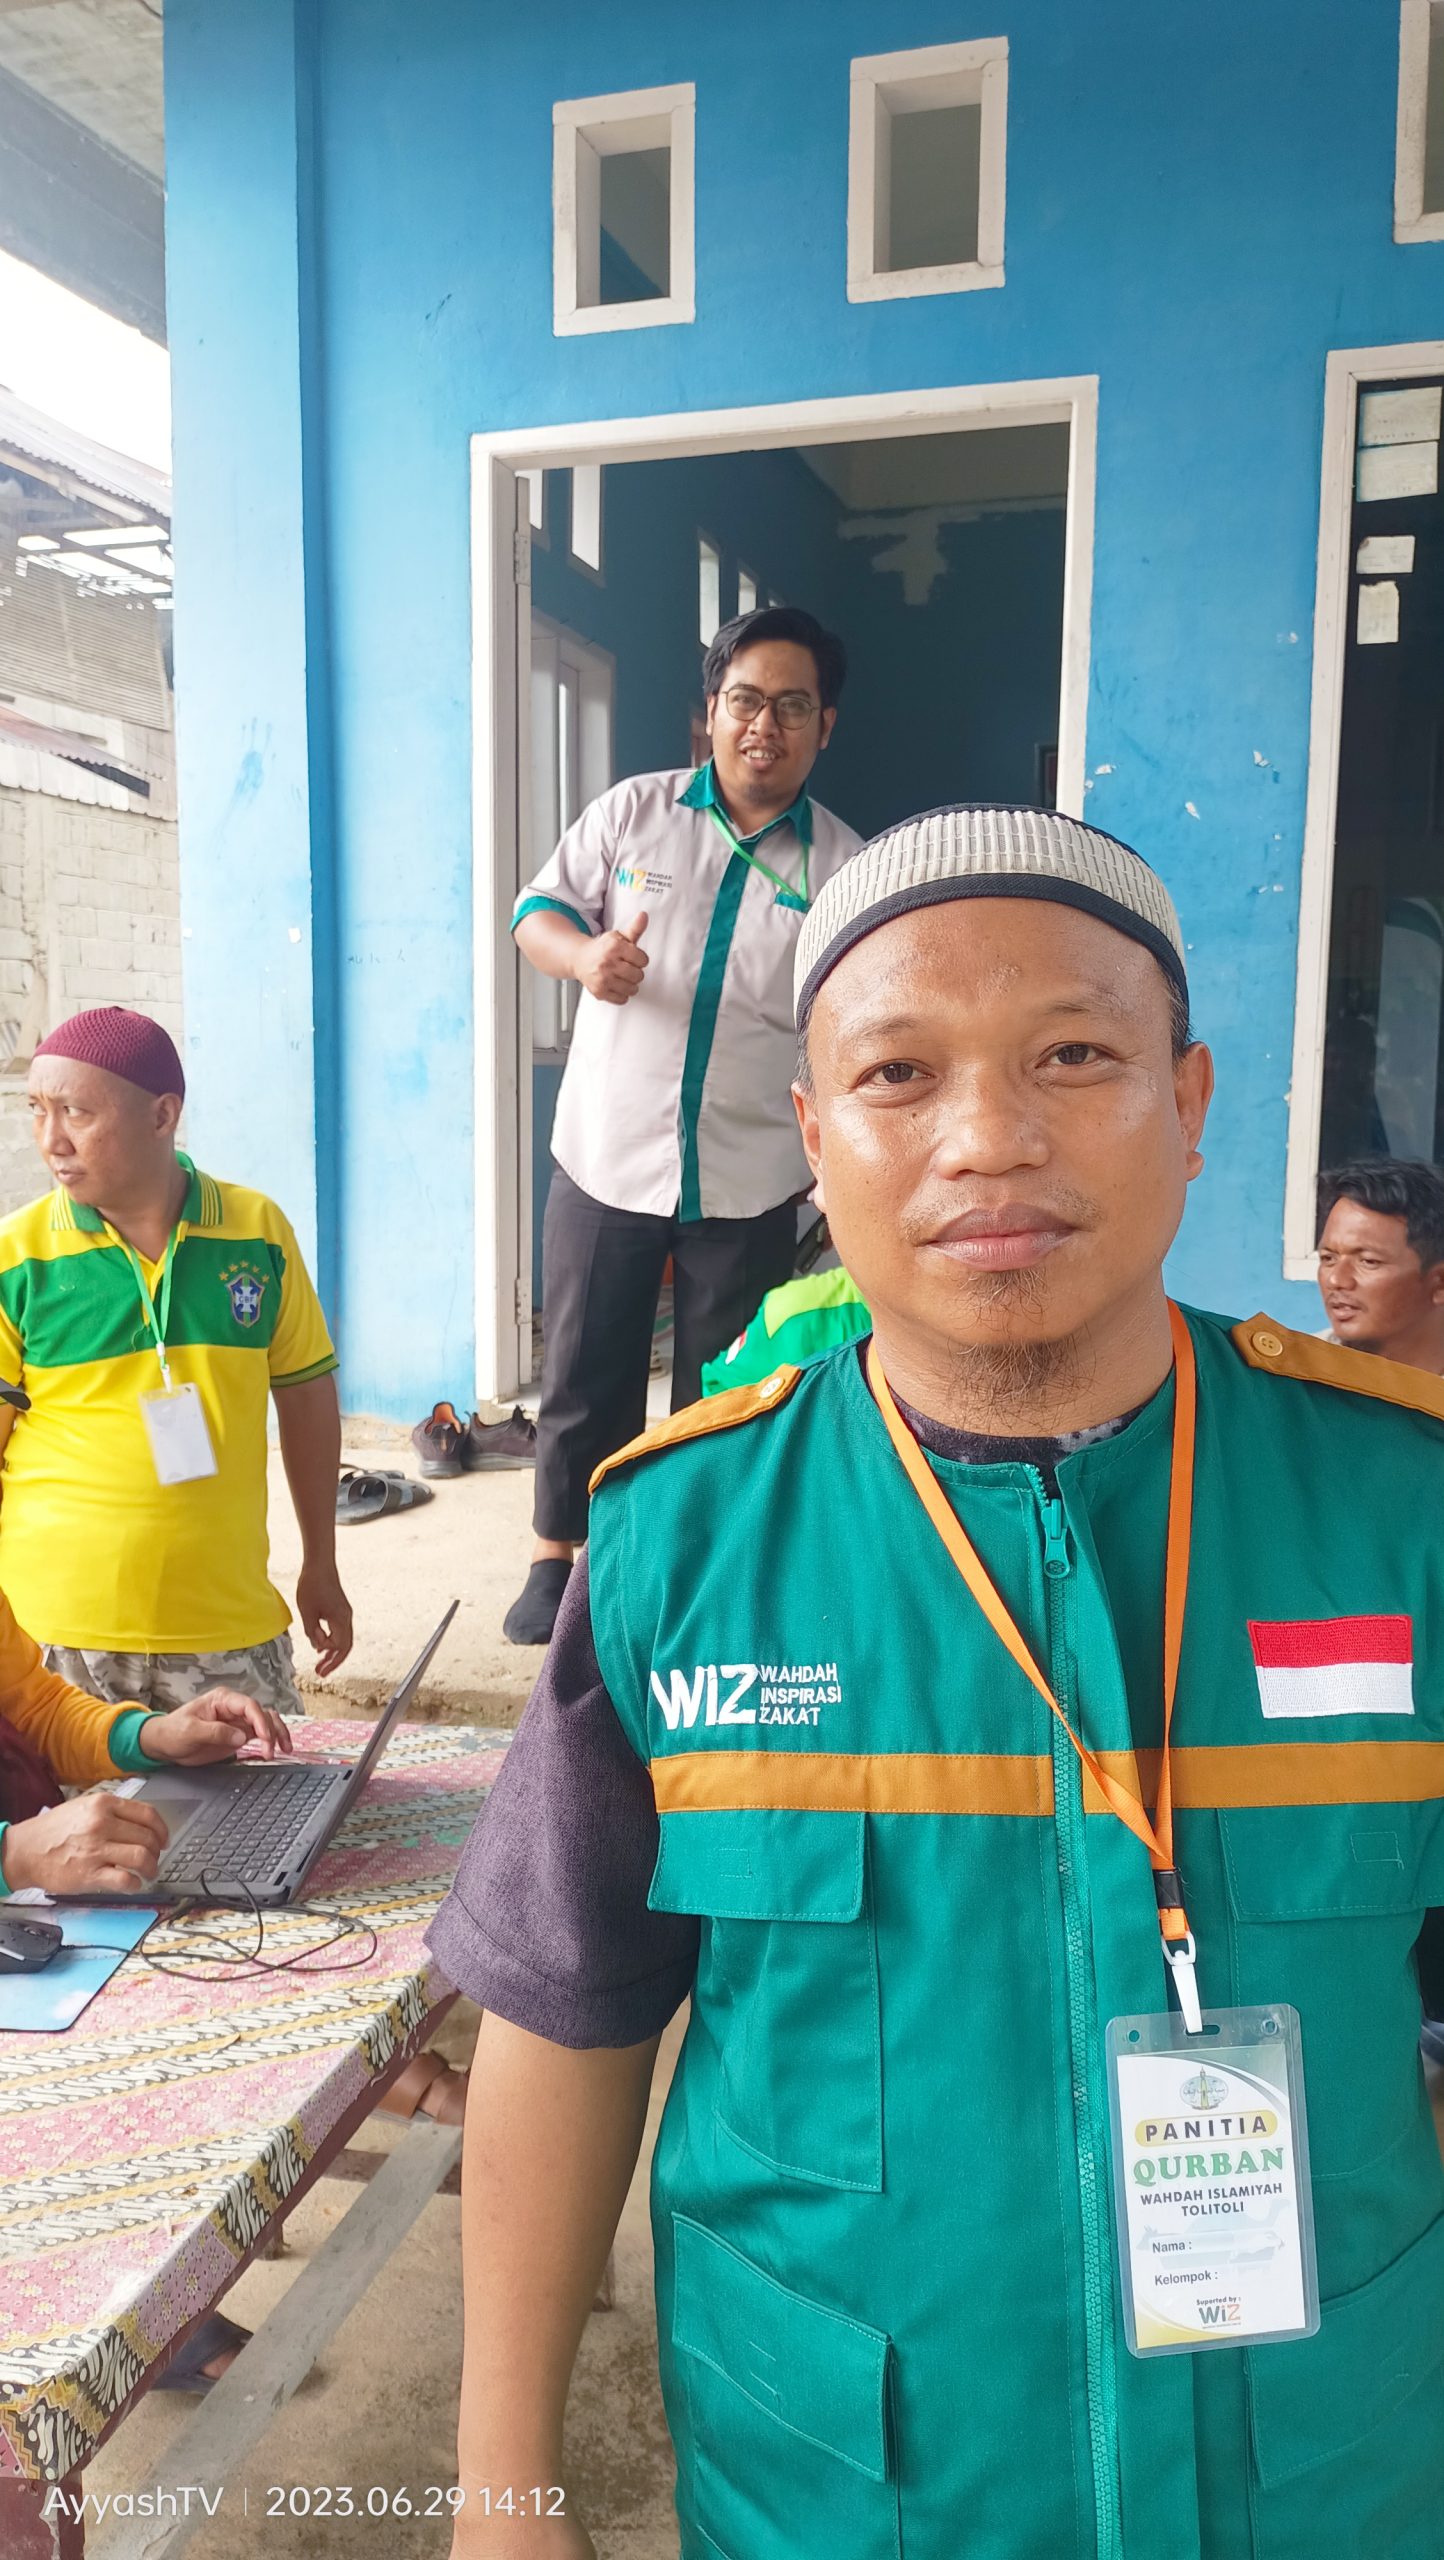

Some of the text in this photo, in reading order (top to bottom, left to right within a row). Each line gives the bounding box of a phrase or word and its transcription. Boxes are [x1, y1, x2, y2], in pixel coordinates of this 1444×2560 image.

[760, 1663, 838, 1683] WAHDAH
[760, 1685, 842, 1704] INSPIRASI
[758, 1706, 821, 1726] ZAKAT
[1146, 2116, 1267, 2141] PANITIA
[1134, 2148, 1284, 2187] QURBAN
[1140, 2182, 1283, 2206] WAHDAH ISLAMIYAH
[1181, 2202, 1244, 2217] TOLITOLI
[1152, 2240, 1185, 2253] Nama
[1154, 2270, 1212, 2286] Kelompok
